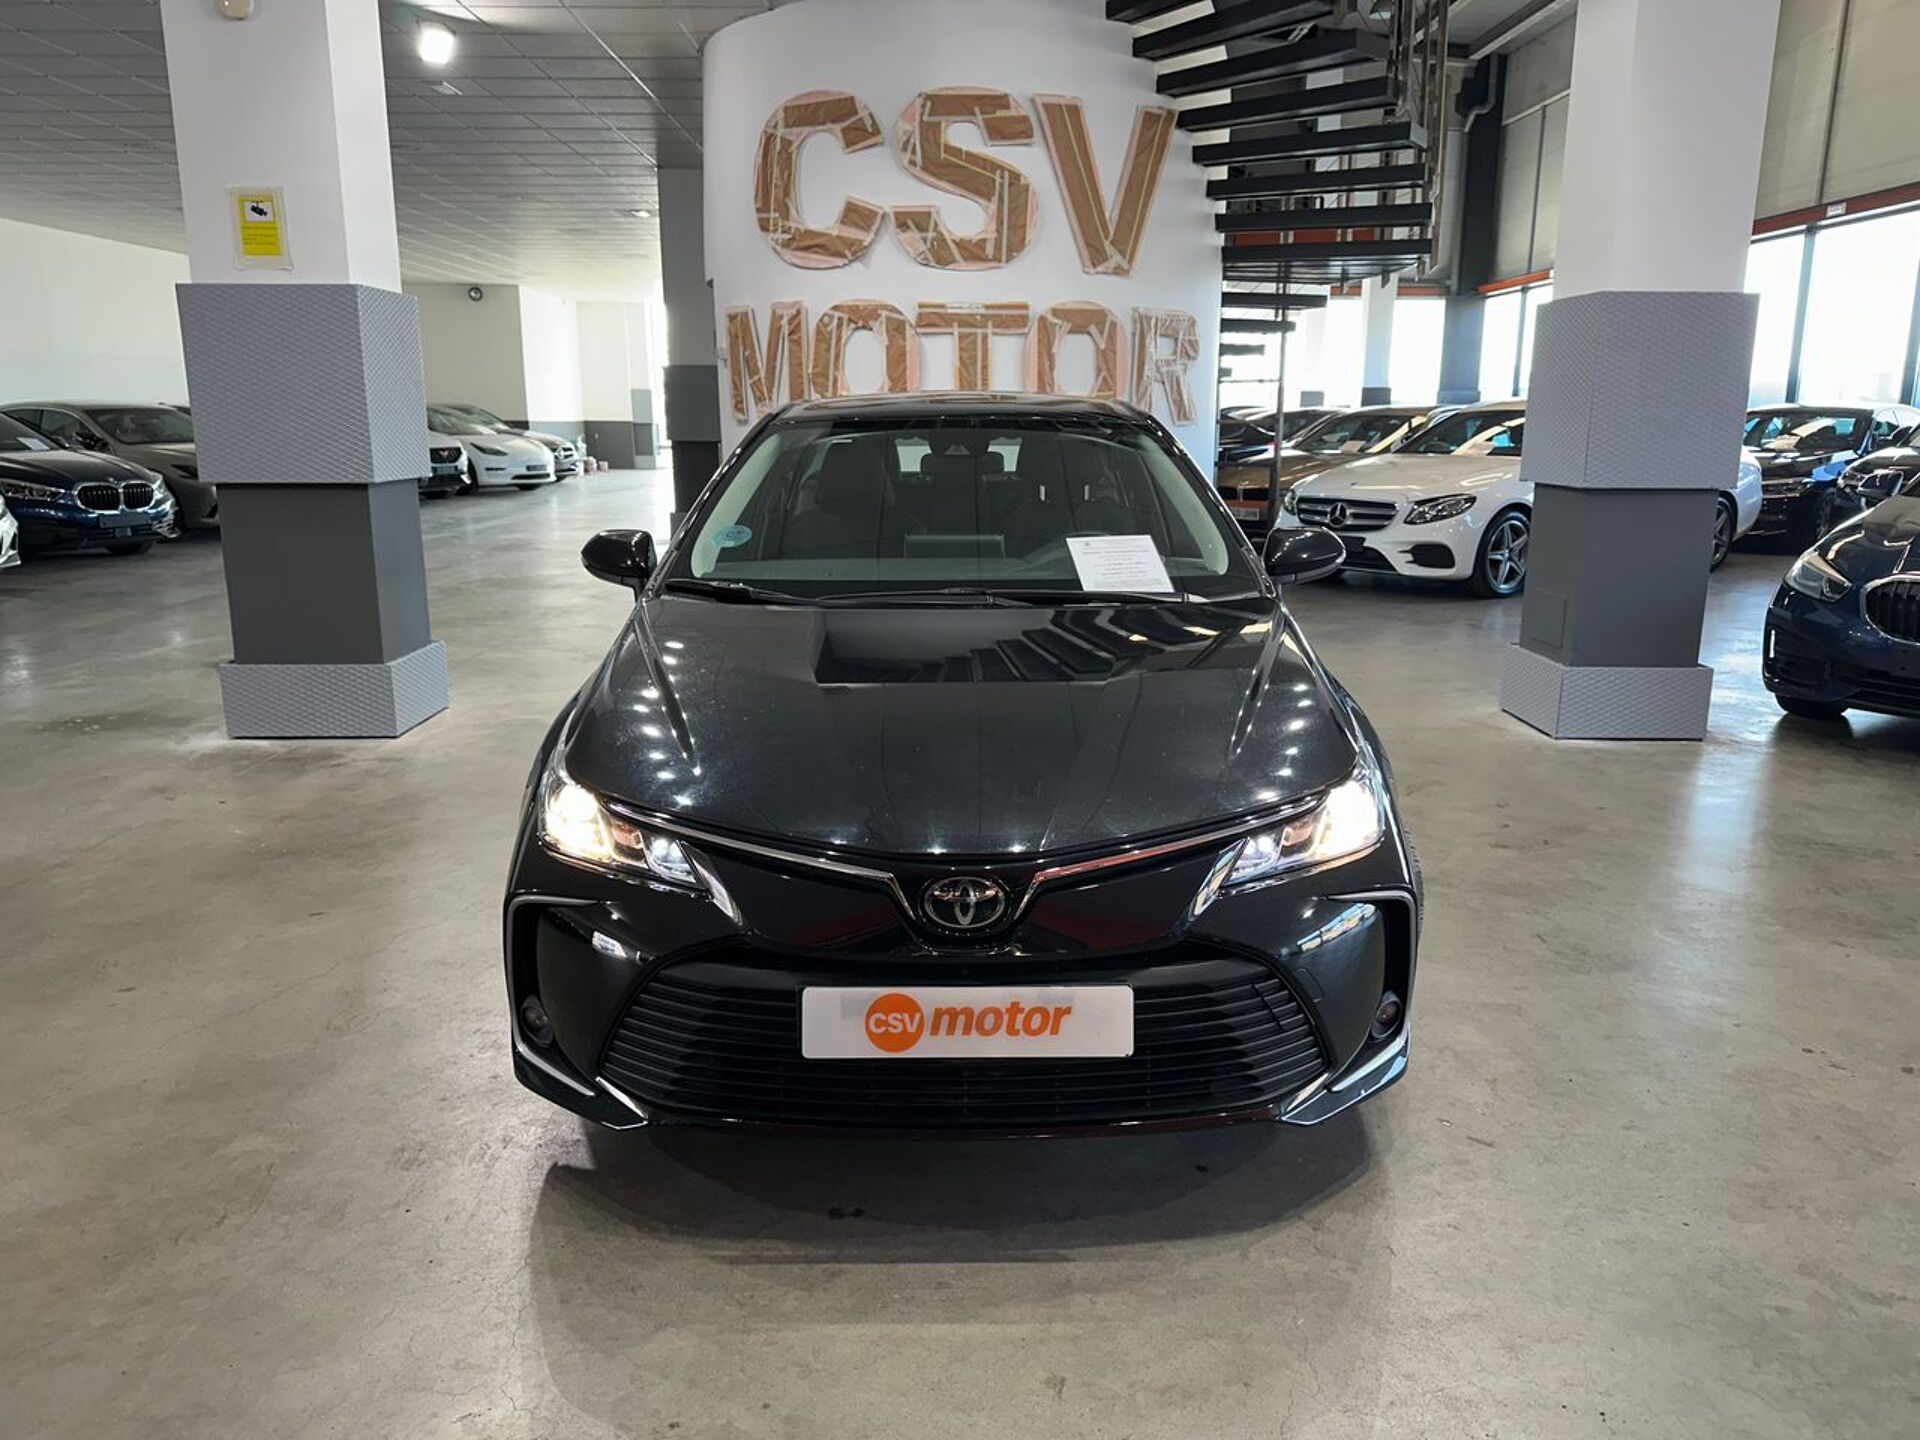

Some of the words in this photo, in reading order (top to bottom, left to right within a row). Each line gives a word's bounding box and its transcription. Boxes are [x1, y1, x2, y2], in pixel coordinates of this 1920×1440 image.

[753, 86, 1178, 277] CSV
[725, 299, 1201, 425] MOTOR
[867, 1011, 922, 1034] CSV
[929, 1001, 1072, 1037] motor
